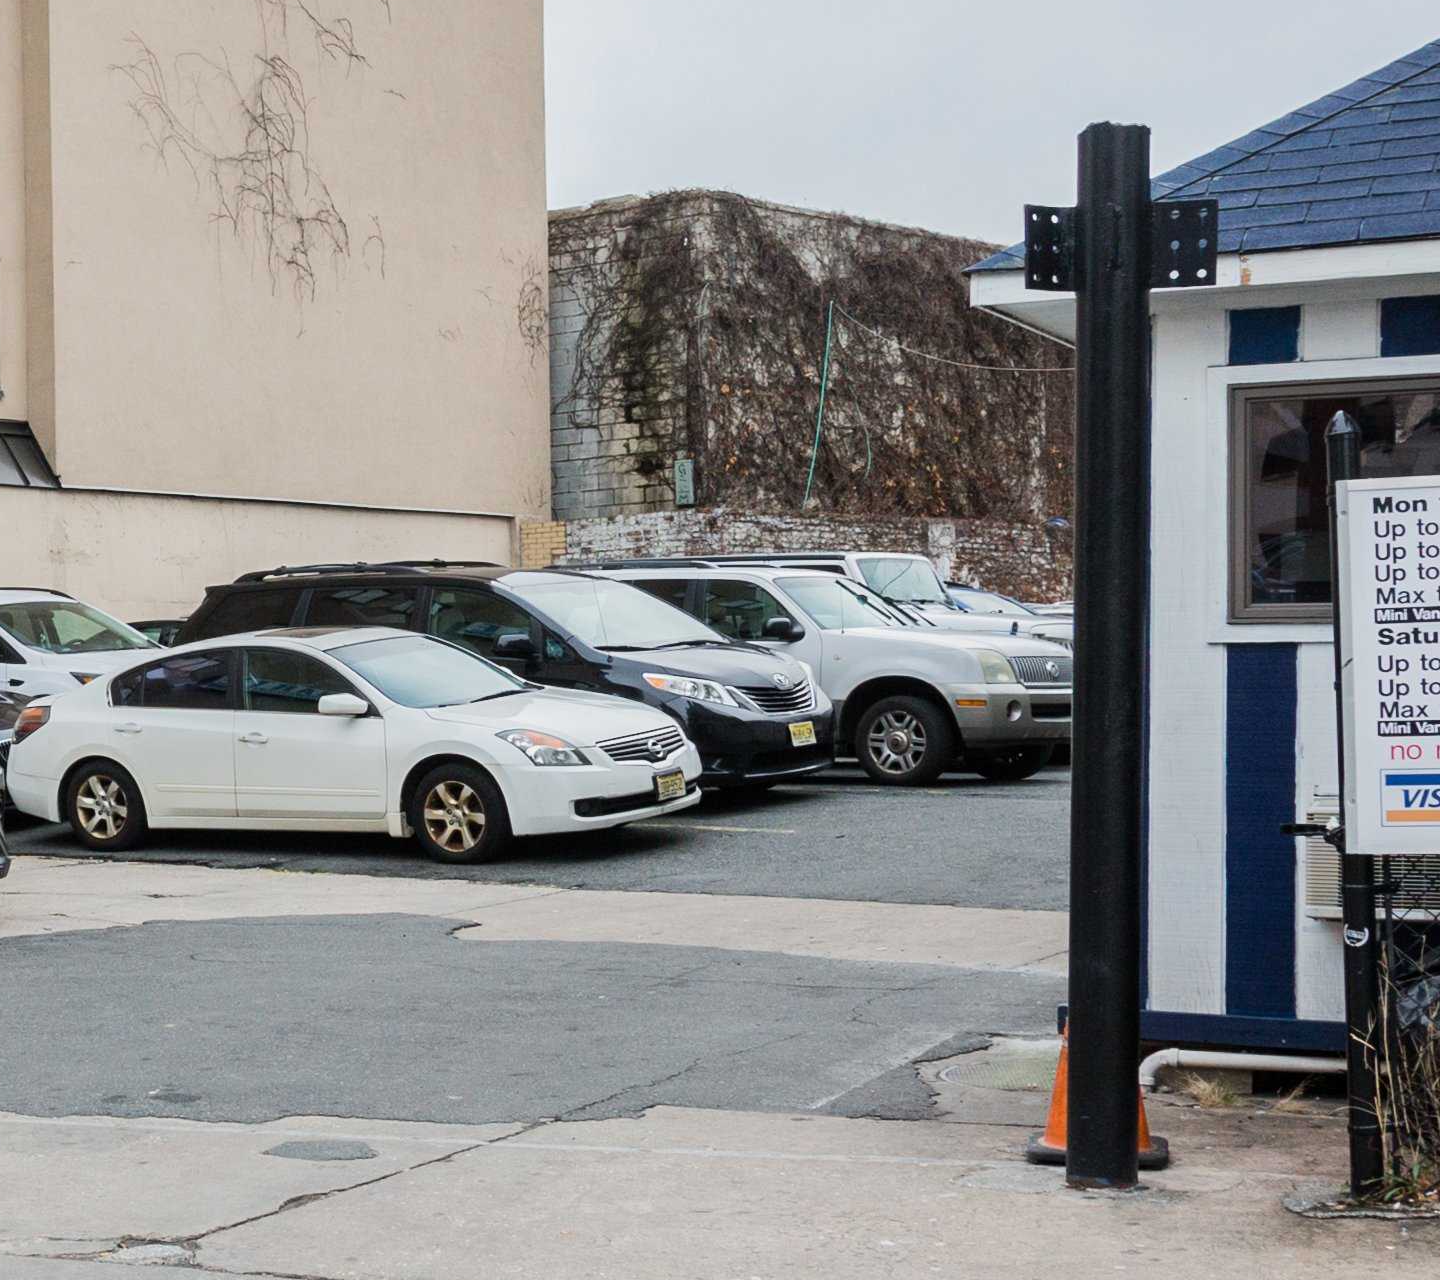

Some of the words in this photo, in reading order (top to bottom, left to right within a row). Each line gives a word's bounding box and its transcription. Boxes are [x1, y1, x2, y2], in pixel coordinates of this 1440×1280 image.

[1373, 497, 1428, 514] Mon
[1374, 521, 1406, 541] Up
[1417, 519, 1439, 536] to
[1375, 543, 1407, 563] Up
[1417, 542, 1440, 558] to
[1375, 565, 1406, 585] Up
[1418, 564, 1440, 580] to
[1376, 587, 1425, 605] Max
[1376, 609, 1407, 622] Mini
[1377, 653, 1409, 675] Up
[1378, 677, 1410, 700] Up
[1380, 700, 1428, 719] Max
[1380, 722, 1411, 735] Mini
[1390, 742, 1422, 760] no
